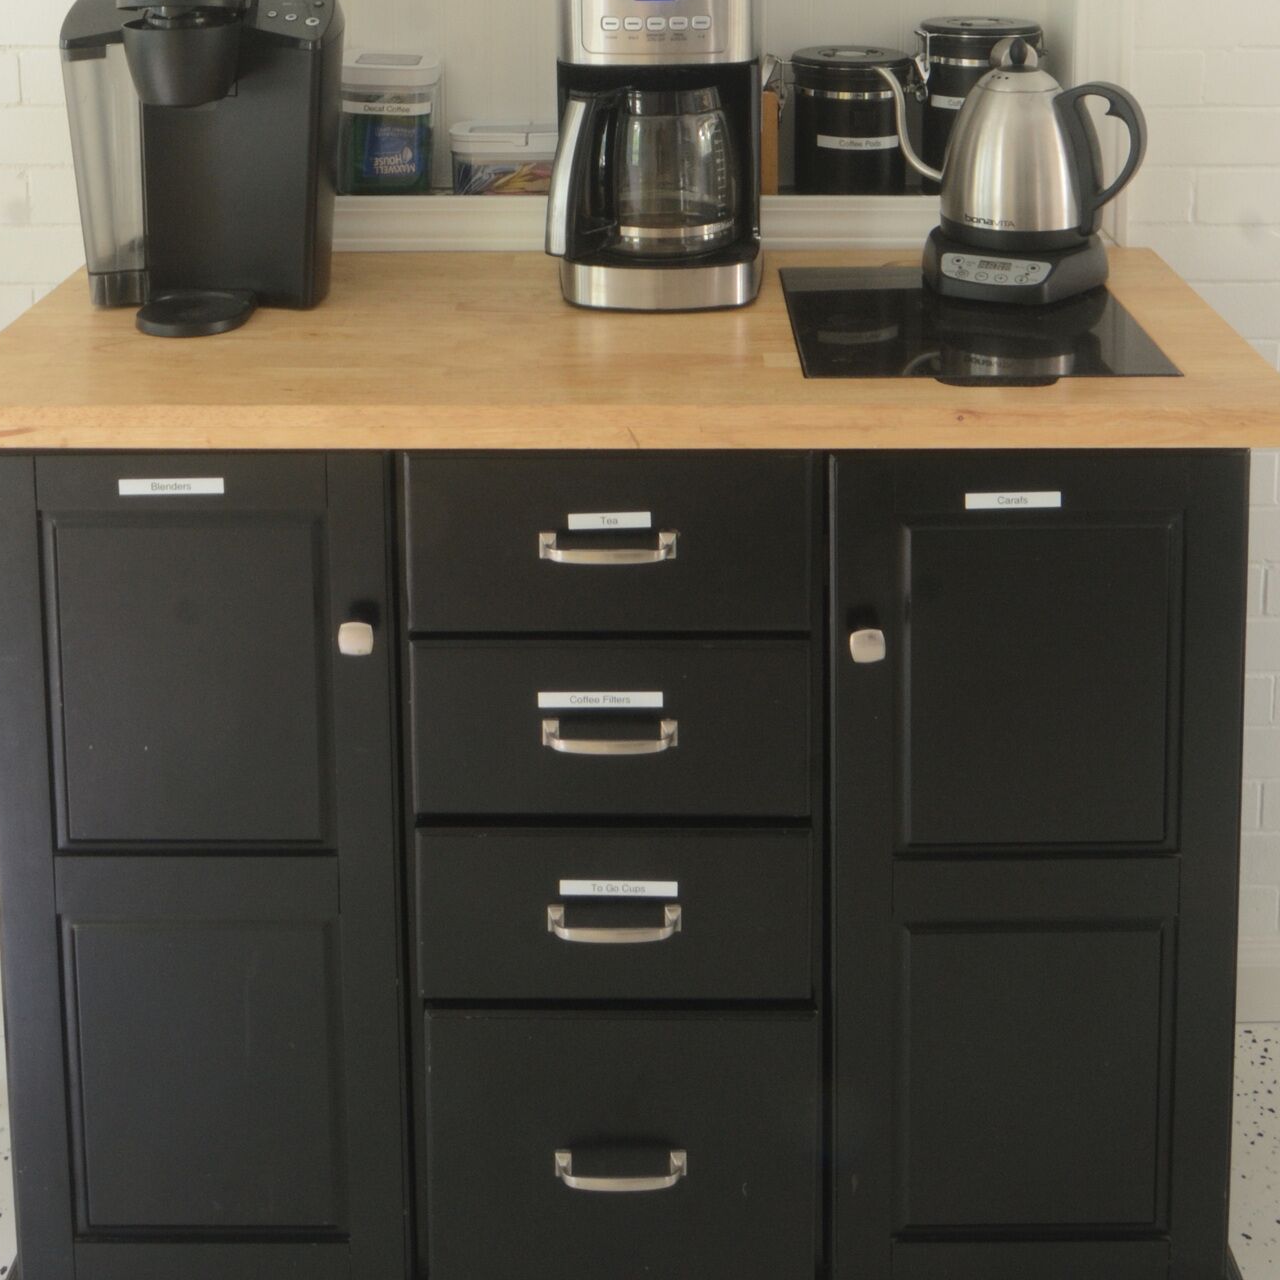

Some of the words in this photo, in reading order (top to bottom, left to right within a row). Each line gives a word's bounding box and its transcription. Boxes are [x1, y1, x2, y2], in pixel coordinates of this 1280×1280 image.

[363, 104, 385, 112] Decaf
[386, 105, 410, 113] Coffee
[838, 138, 863, 148] Coffee
[374, 153, 403, 166] HOUSE
[373, 163, 416, 175] MAXWELL
[150, 482, 192, 491] Blenders
[600, 516, 618, 525] Tea
[569, 695, 600, 704] Coffee
[602, 695, 631, 704] Filters
[591, 883, 603, 892] To
[605, 883, 619, 892] Go
[621, 884, 646, 894] Cups
